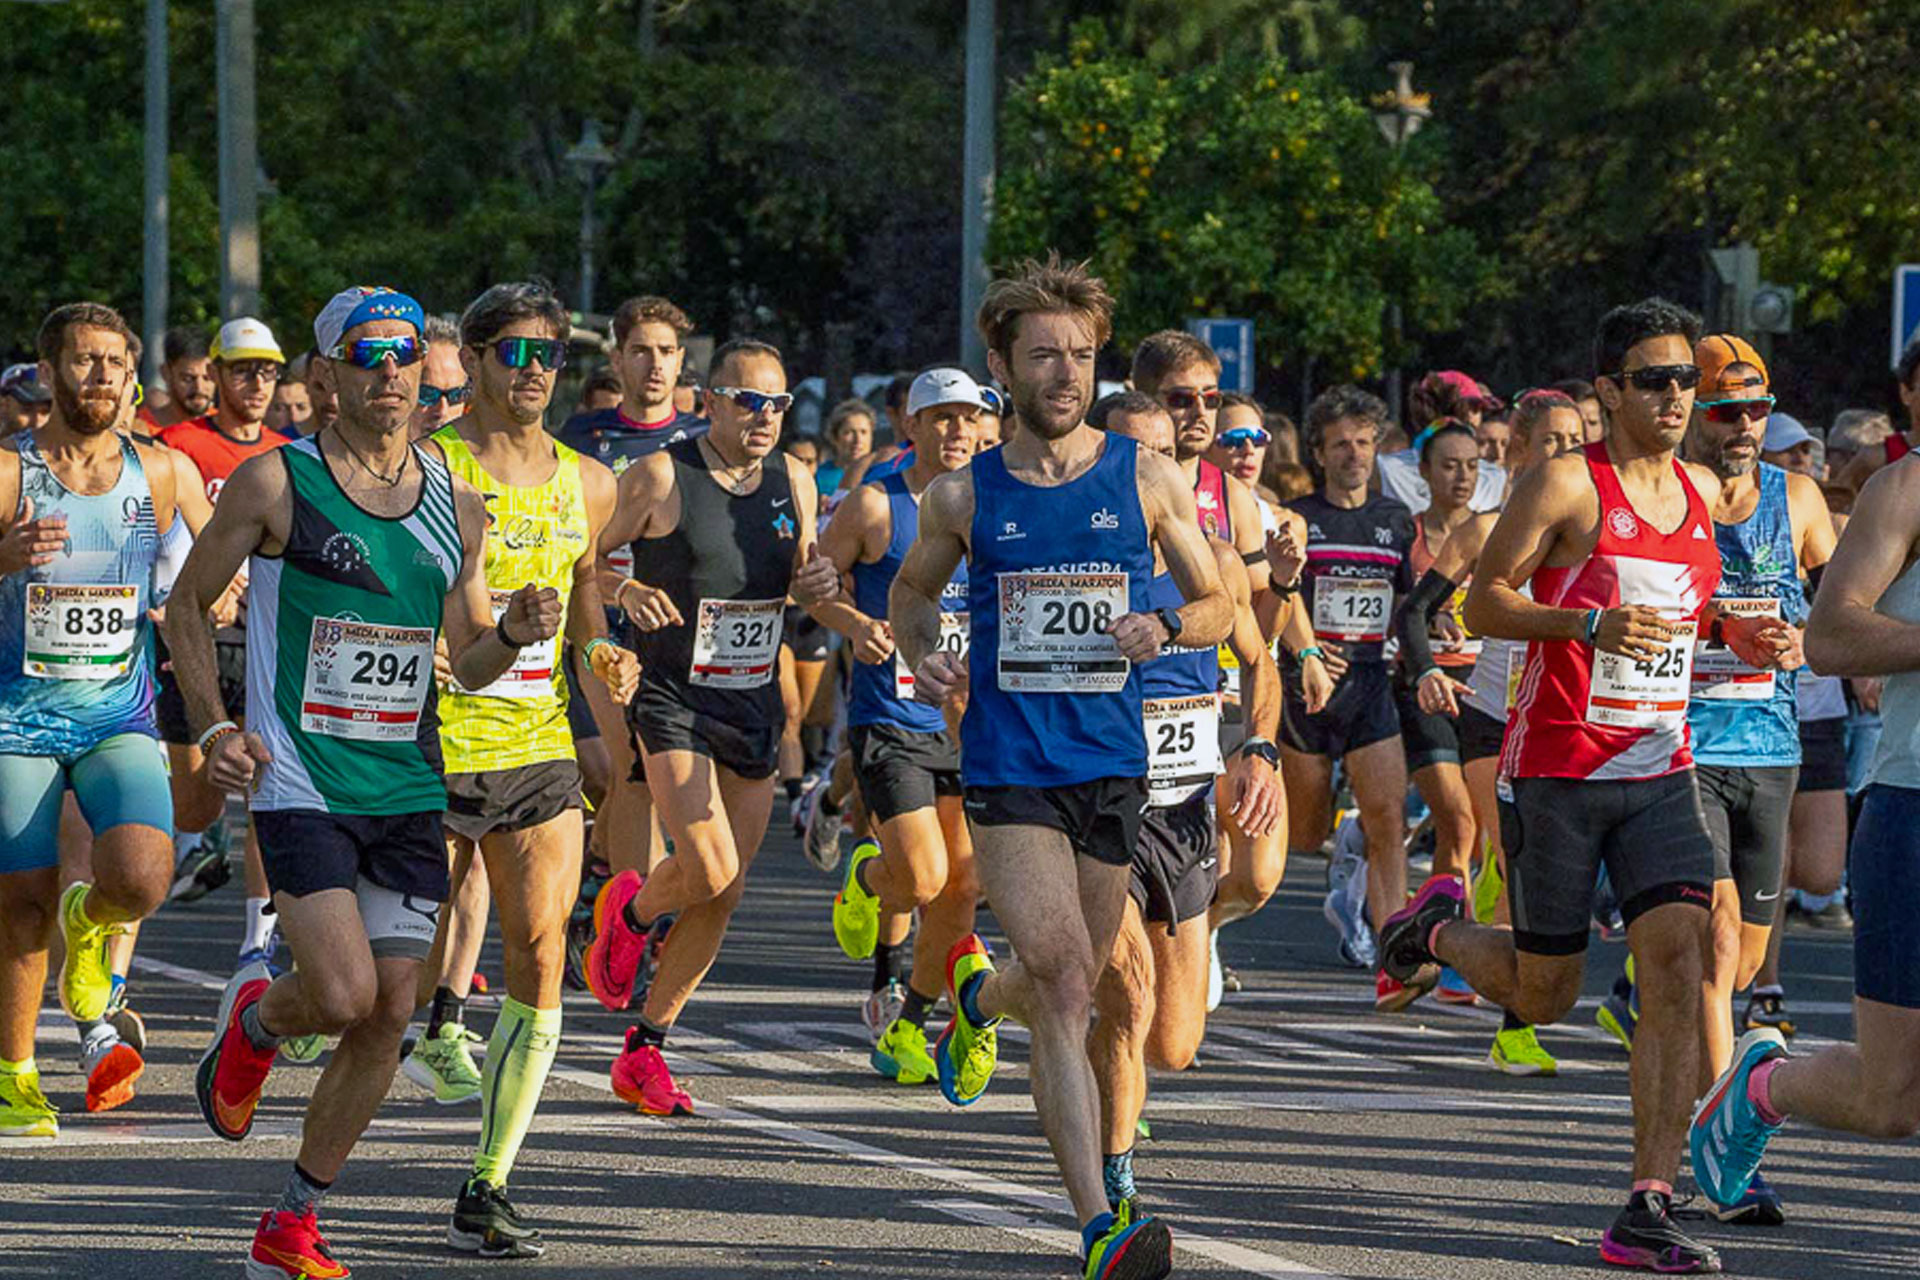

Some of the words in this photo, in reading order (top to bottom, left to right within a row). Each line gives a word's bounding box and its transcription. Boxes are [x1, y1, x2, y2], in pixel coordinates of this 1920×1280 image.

[56, 588, 84, 597] MEDIA
[1029, 578, 1066, 588] MEDIA
[1043, 601, 1112, 635] 208
[1344, 596, 1383, 618] 123
[65, 608, 123, 635] 838
[345, 627, 380, 639] MEDIA
[731, 620, 774, 648] 321
[350, 650, 419, 688] 294
[1635, 648, 1685, 678] 425
[1157, 721, 1195, 755] 25
